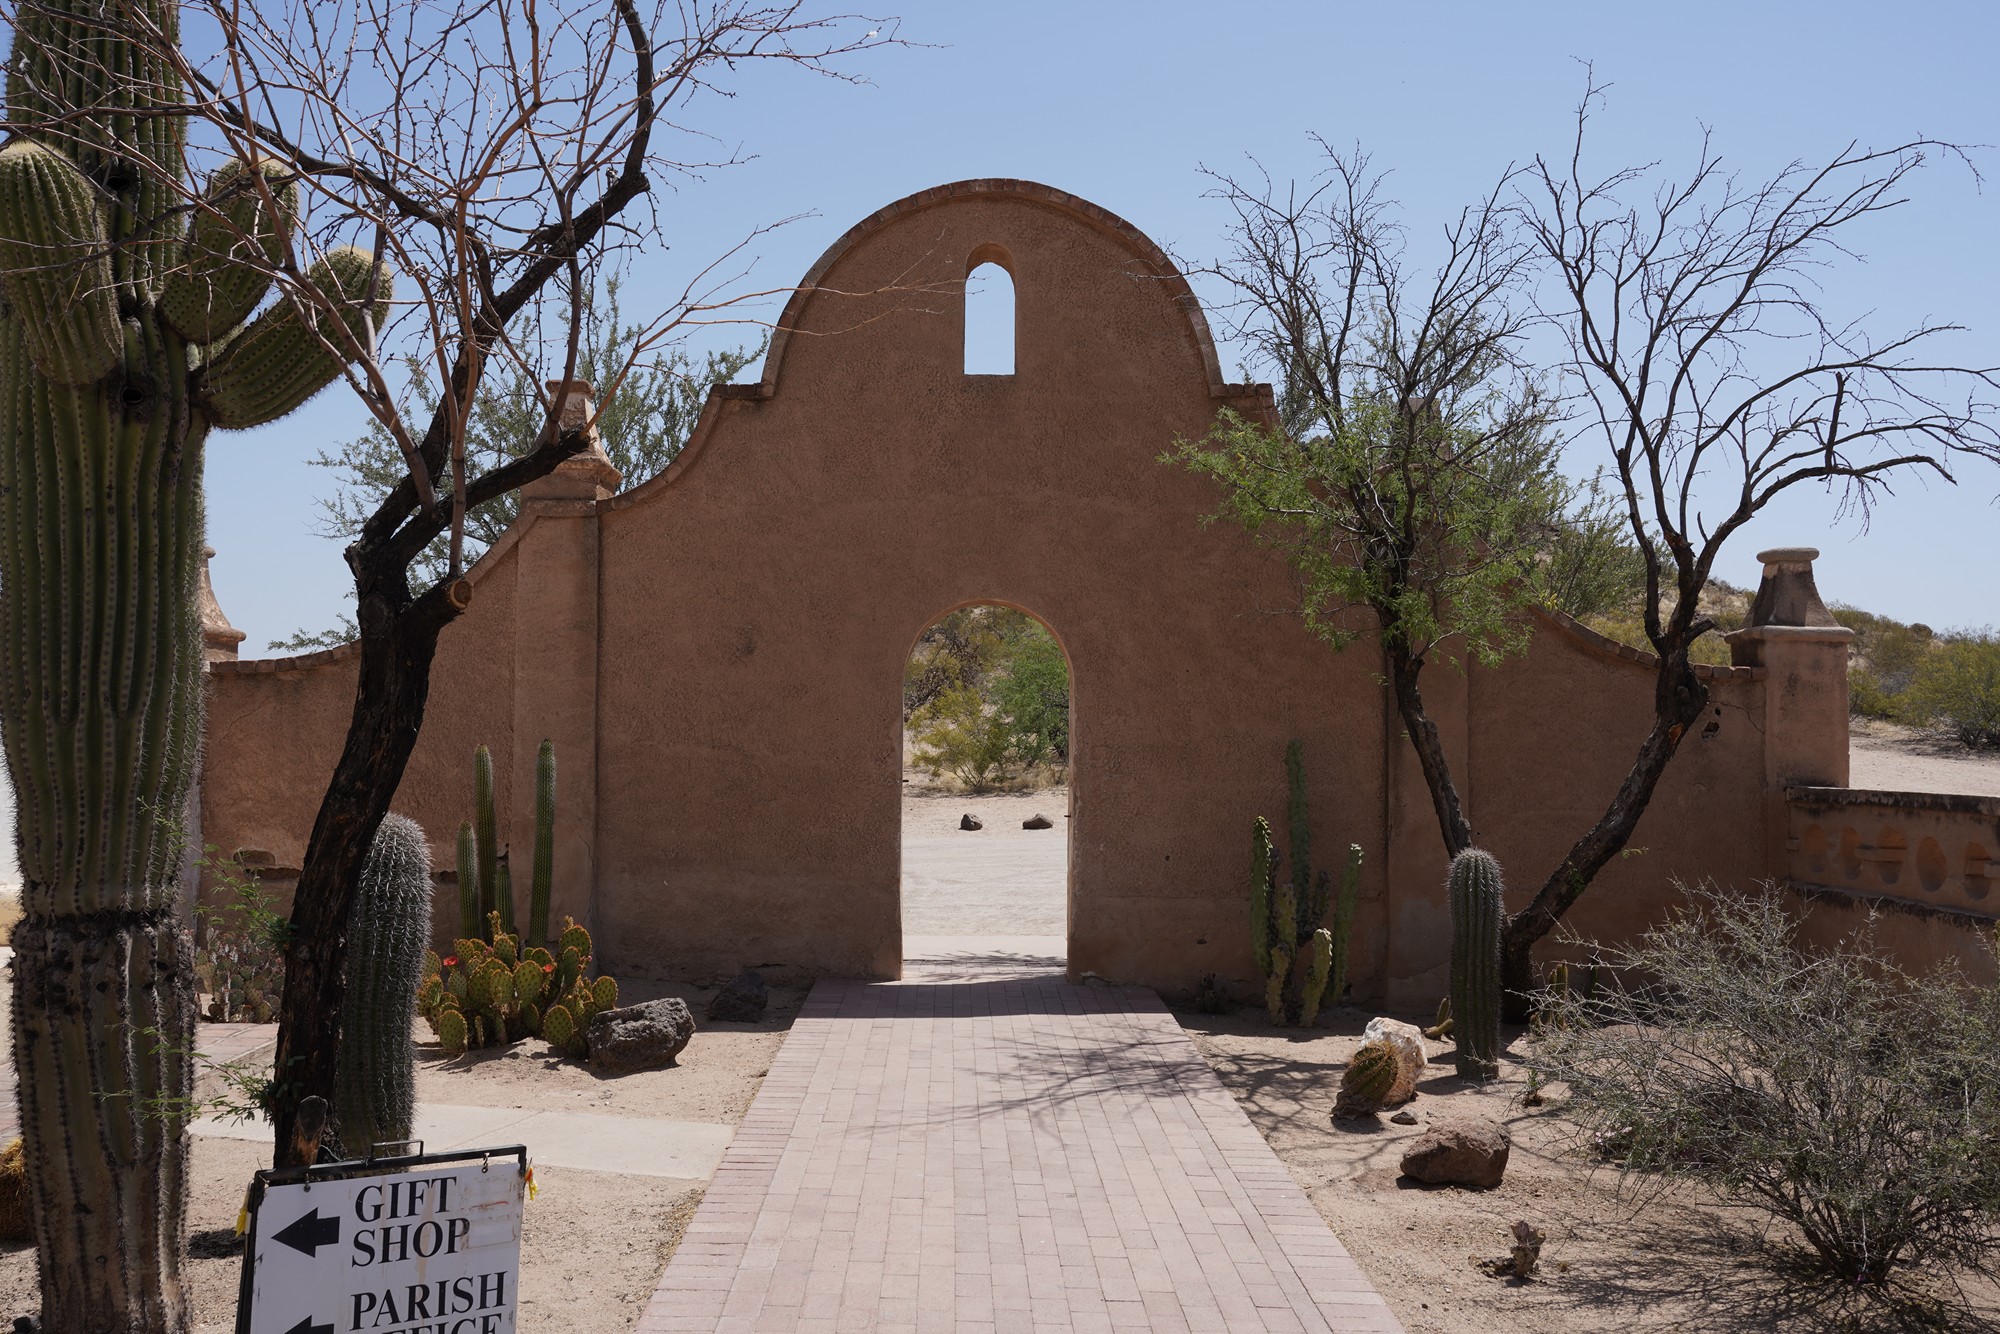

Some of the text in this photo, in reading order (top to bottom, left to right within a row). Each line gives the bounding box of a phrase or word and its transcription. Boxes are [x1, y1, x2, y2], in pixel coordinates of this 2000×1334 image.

[355, 1176, 457, 1223] GIFT
[352, 1217, 471, 1268] SHOP
[349, 1271, 509, 1331] PARISH
